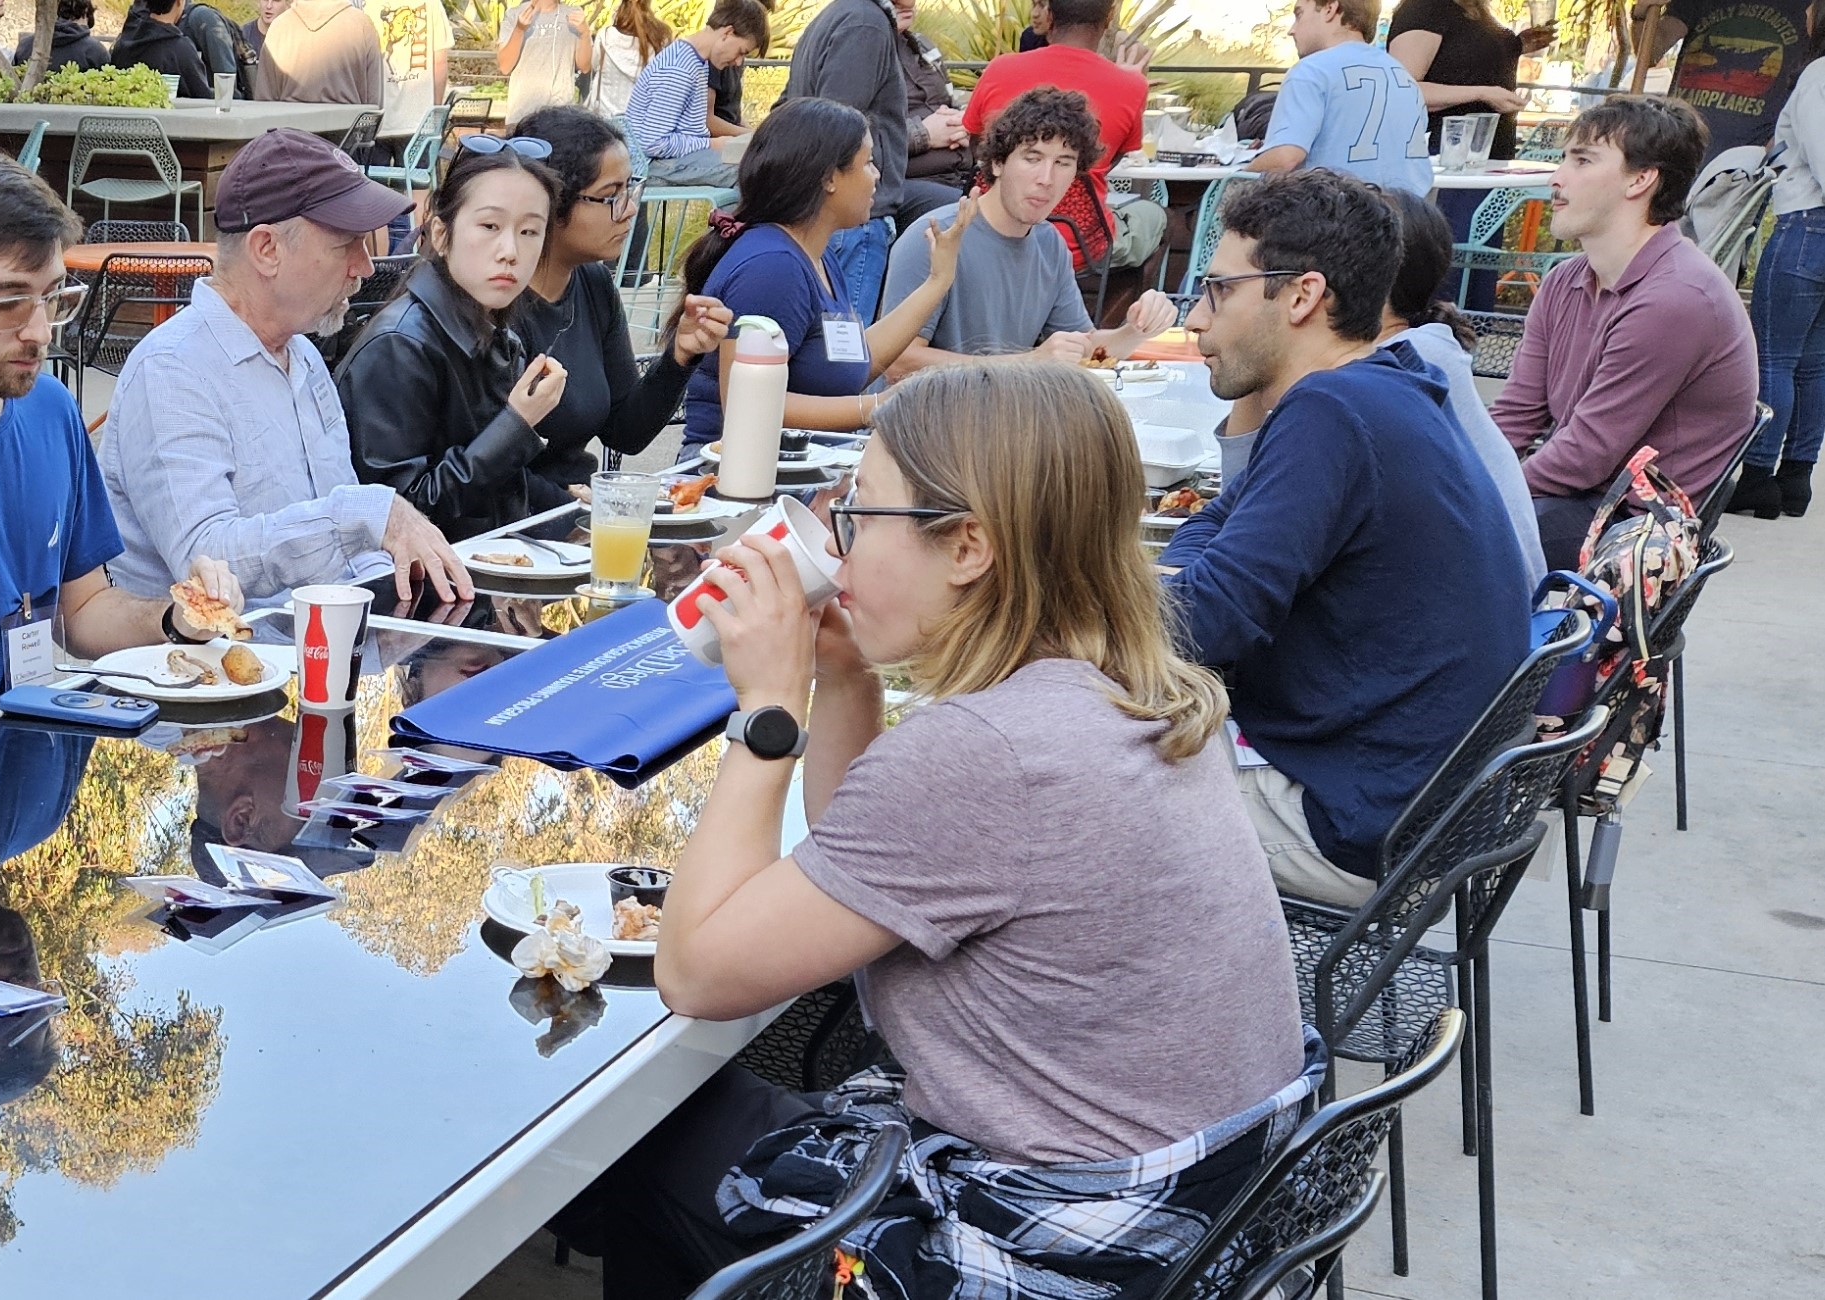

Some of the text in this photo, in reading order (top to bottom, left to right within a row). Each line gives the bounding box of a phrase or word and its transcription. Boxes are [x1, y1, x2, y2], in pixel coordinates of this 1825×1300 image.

[1737, 3, 1799, 45] DISTRACTED
[1341, 64, 1429, 163] 77
[1685, 88, 1766, 116] AIRPLANES
[600, 659, 684, 689] Diego
